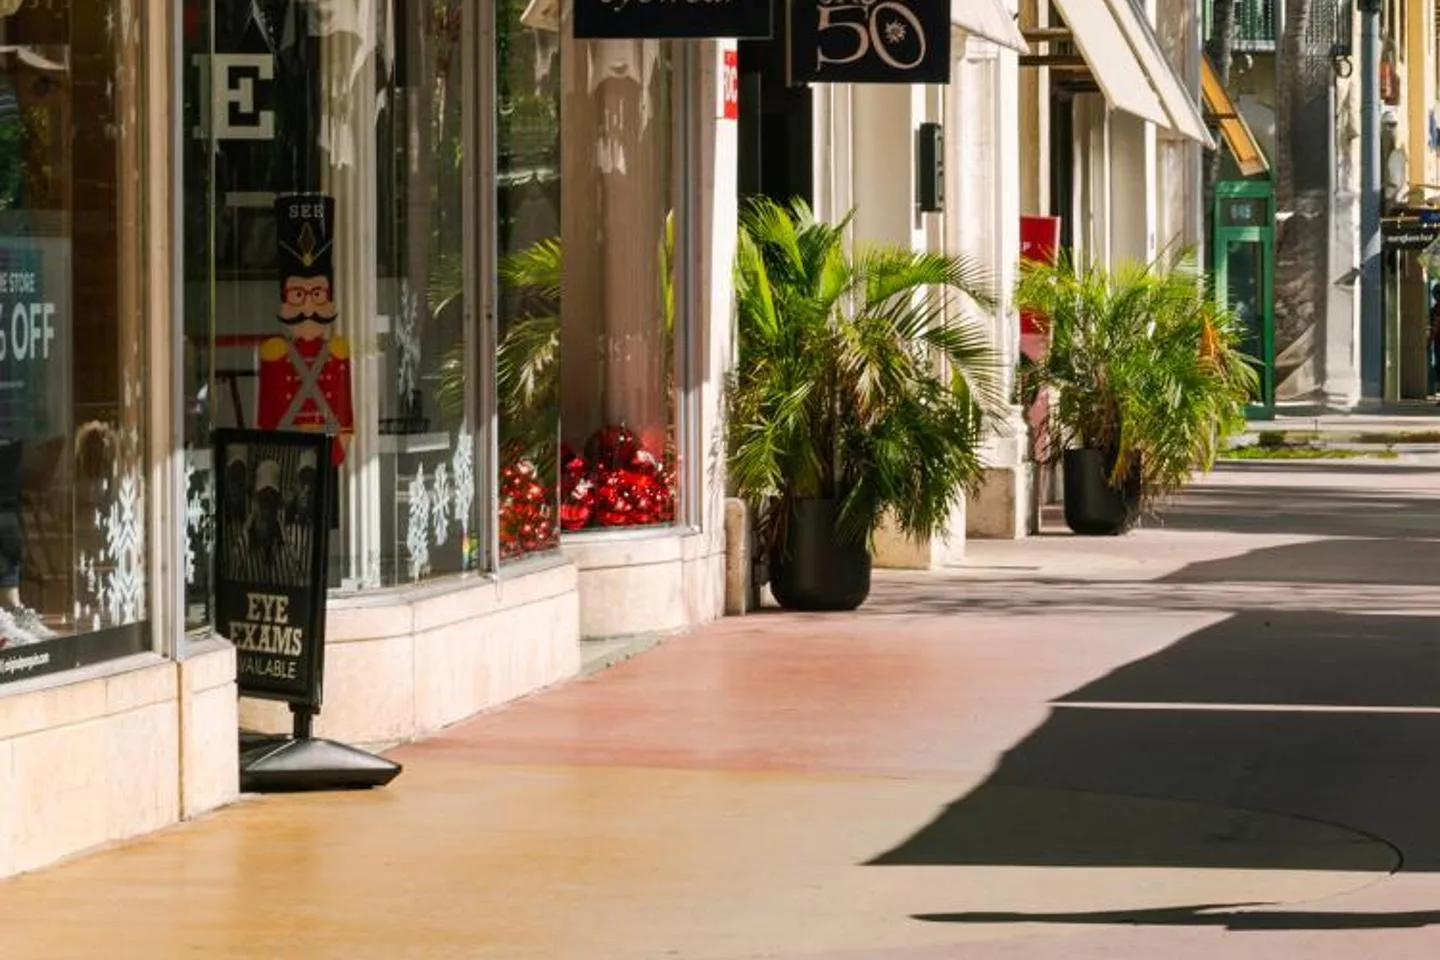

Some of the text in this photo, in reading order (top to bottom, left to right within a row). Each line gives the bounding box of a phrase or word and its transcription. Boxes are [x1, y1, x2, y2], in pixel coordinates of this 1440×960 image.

[816, 1, 926, 71] 50
[11, 302, 55, 361] OFF
[246, 592, 289, 623] EYE
[229, 621, 302, 657] EXAMS
[238, 654, 298, 679] VAILABLE
